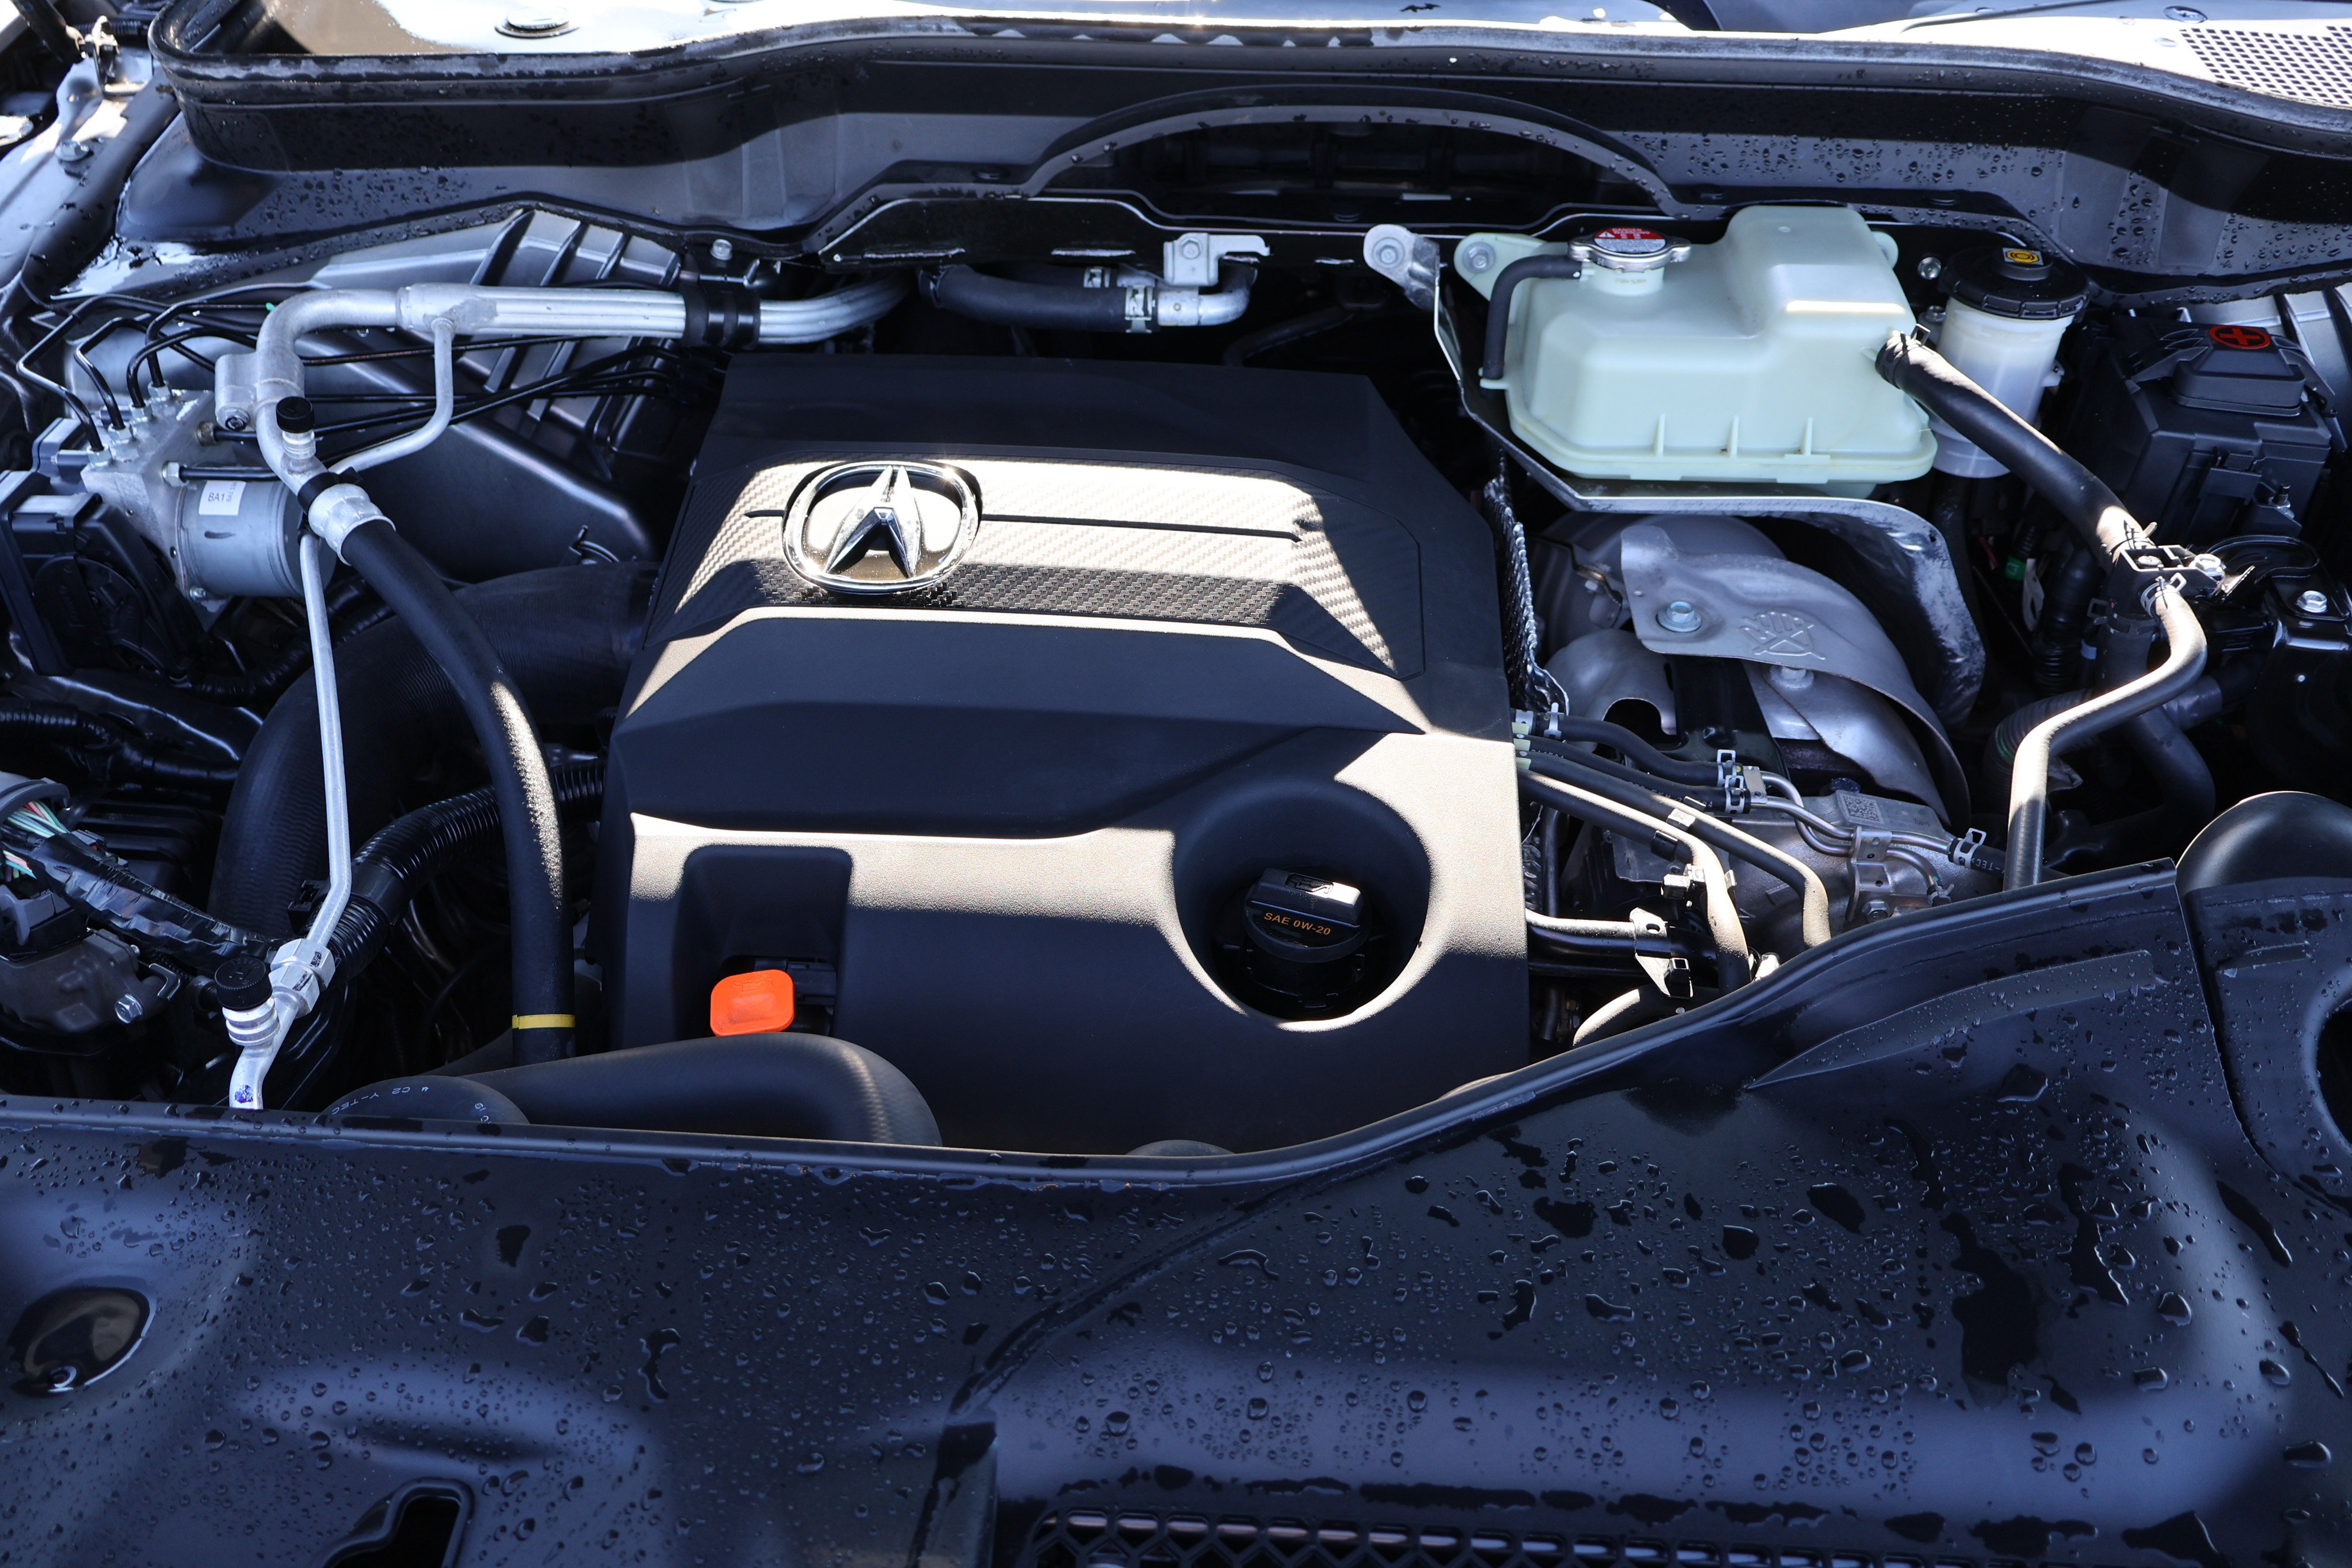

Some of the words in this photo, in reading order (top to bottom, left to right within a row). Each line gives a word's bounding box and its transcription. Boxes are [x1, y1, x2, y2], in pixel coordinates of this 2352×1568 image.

[208, 492, 225, 502] BA1
[1264, 912, 1291, 925] SAE
[1293, 920, 1331, 935] 0W-20
[392, 1086, 411, 1095] C2
[332, 1092, 380, 1115] Y-TEC
